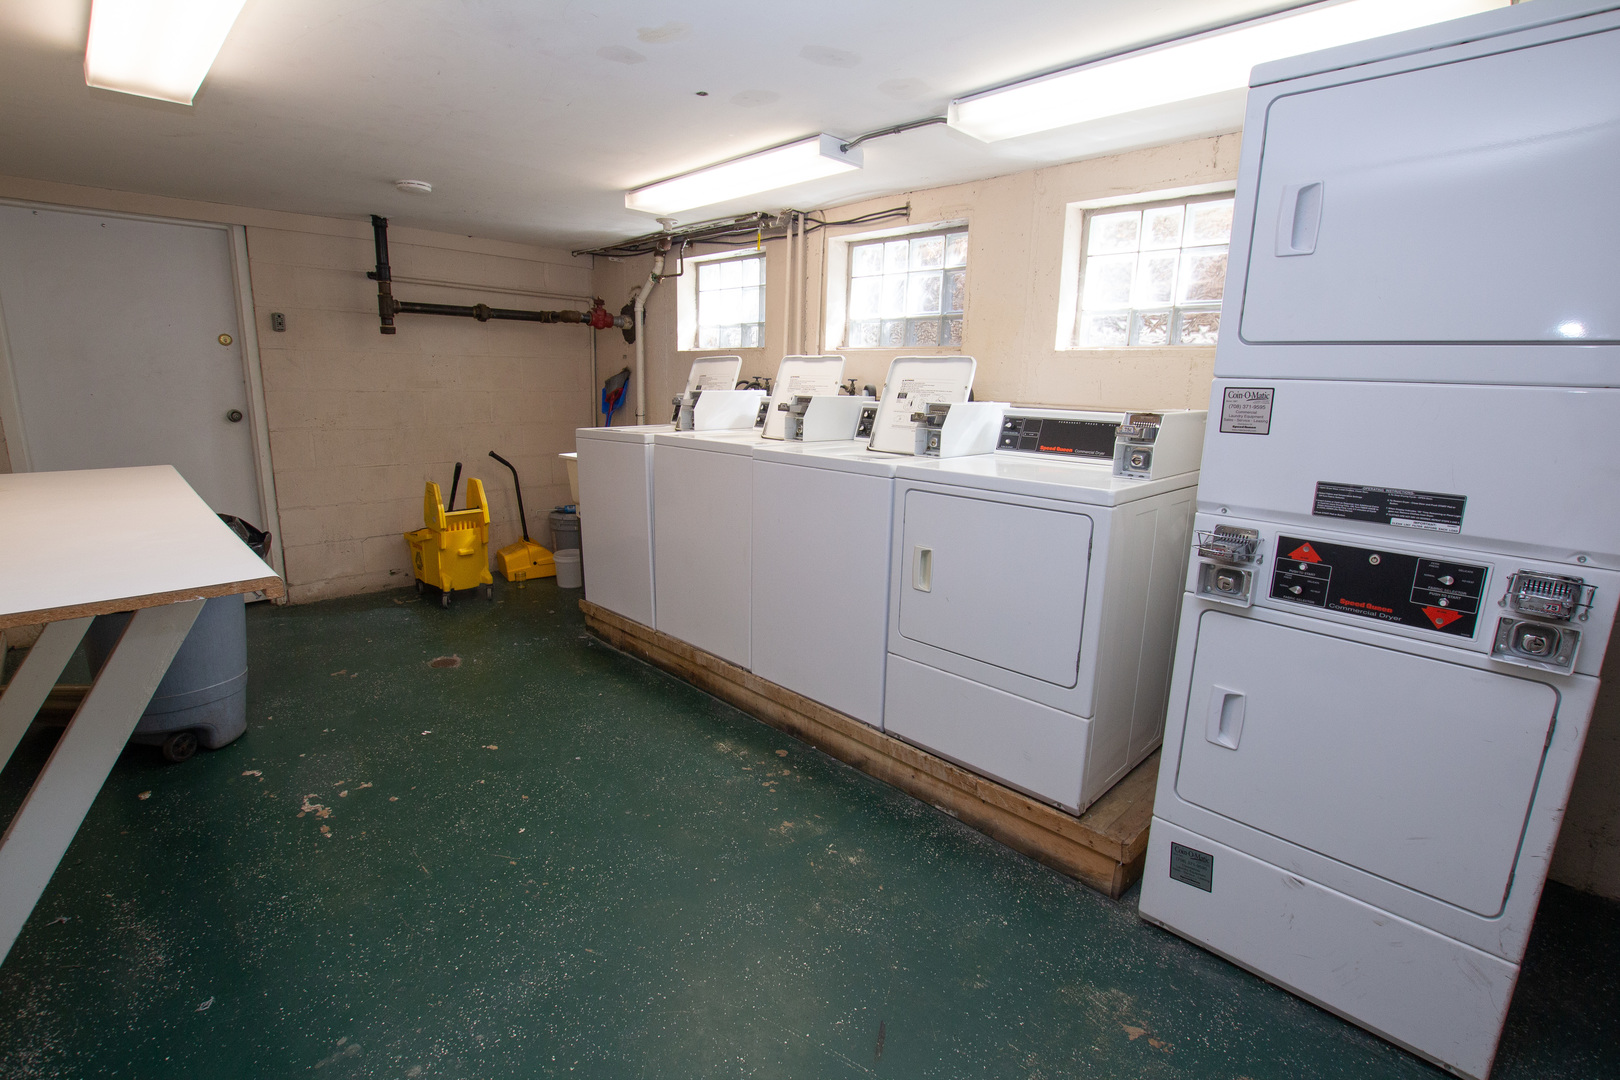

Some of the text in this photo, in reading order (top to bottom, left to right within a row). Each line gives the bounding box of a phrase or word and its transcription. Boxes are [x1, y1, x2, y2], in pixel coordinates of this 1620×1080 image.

[1328, 603, 1402, 621] Commercial Dryer
[1339, 598, 1393, 613] Speed Queen
